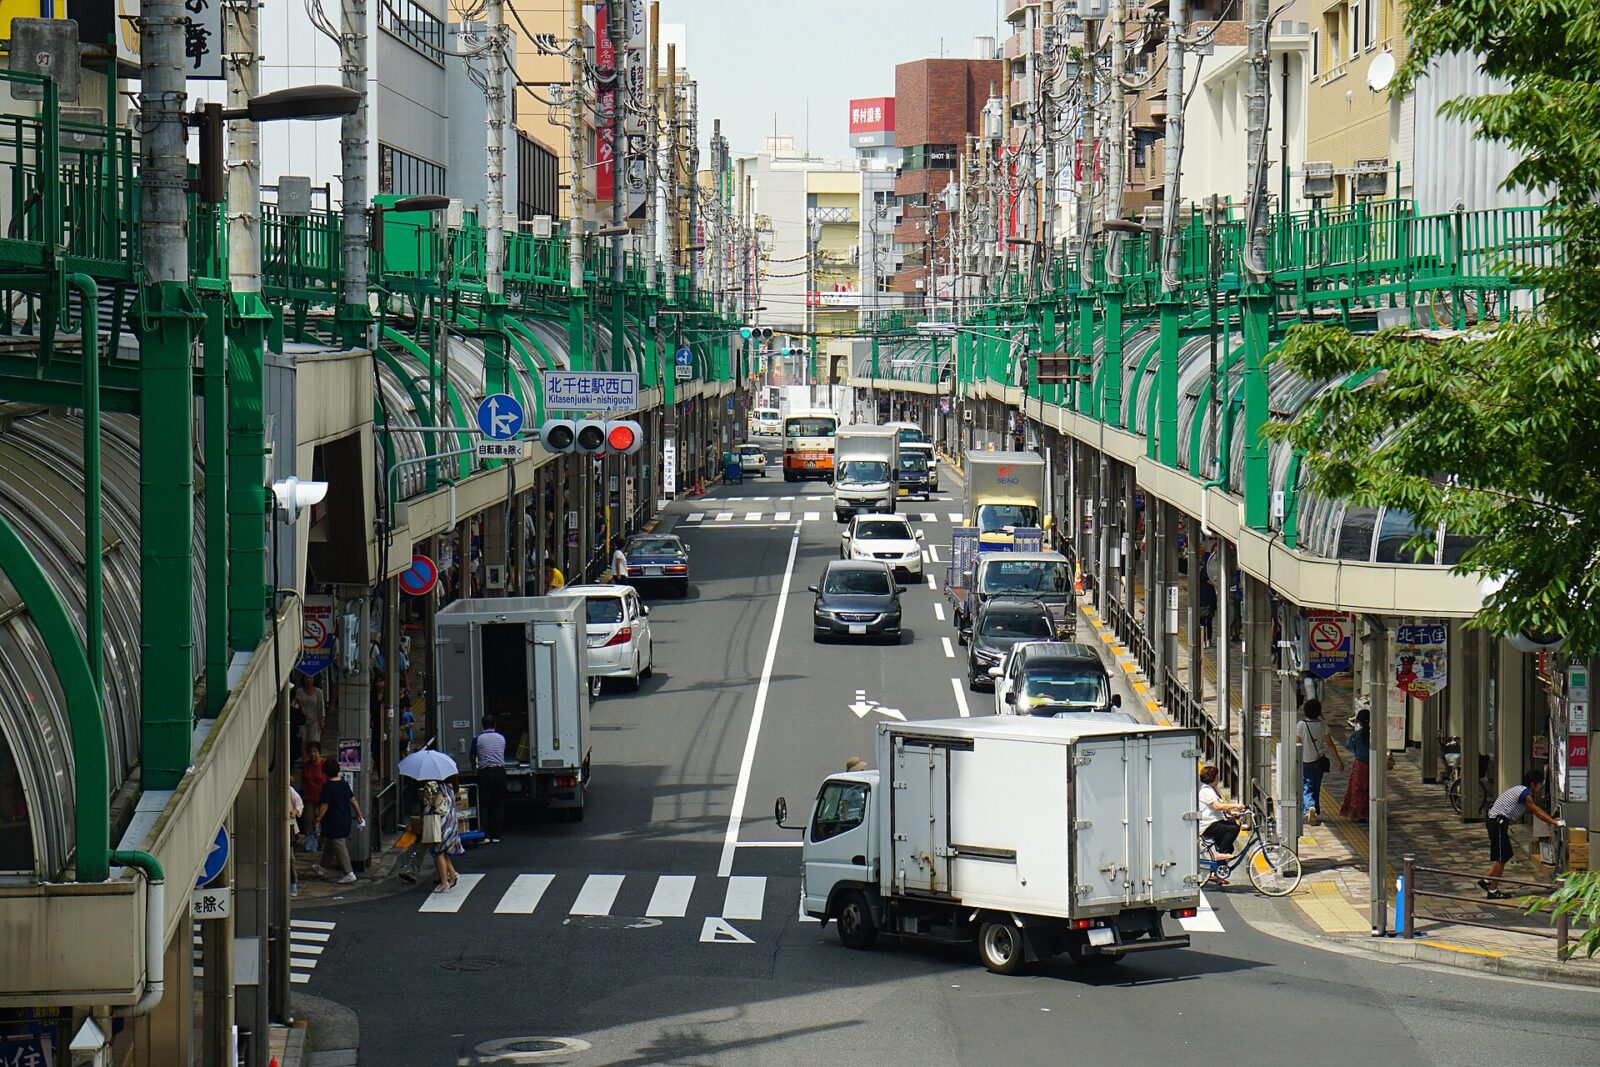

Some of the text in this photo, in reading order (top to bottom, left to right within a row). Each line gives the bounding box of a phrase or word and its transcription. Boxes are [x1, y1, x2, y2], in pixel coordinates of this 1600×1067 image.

[549, 377, 634, 394] 北千住駅西口
[548, 394, 634, 406] Kitasenjueki-nishiguchi
[479, 444, 522, 455] 自転車を除く
[1399, 627, 1446, 643] 北千住
[1570, 746, 1586, 757] JTB
[194, 895, 225, 913] を除く
